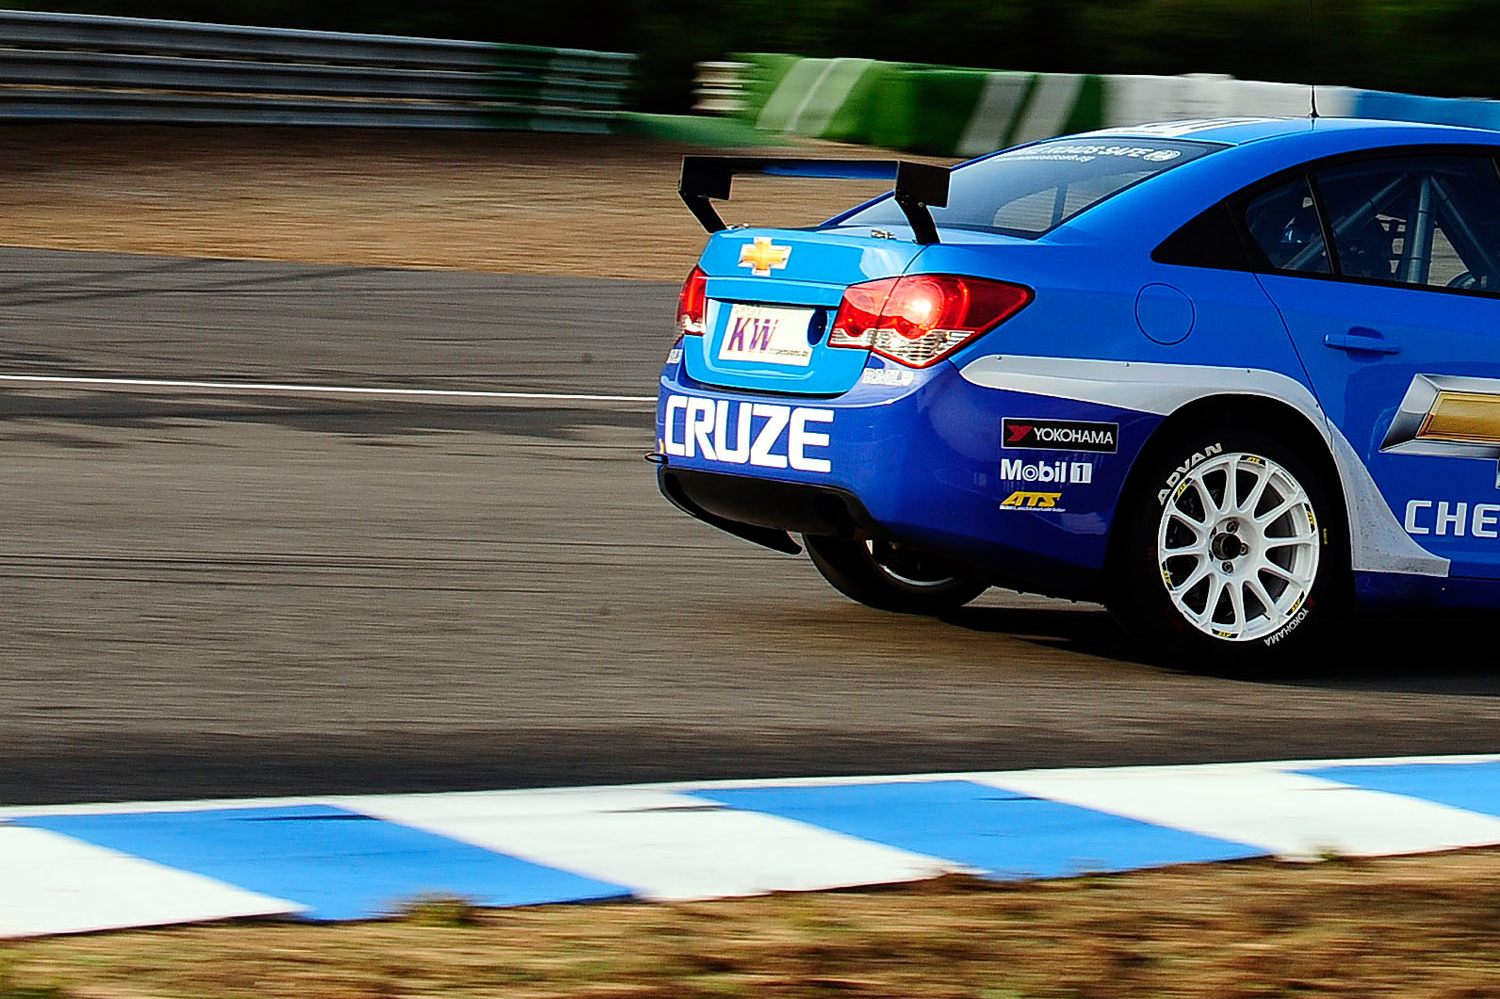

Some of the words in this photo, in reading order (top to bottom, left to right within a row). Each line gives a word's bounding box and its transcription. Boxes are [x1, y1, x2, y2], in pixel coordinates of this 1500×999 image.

[727, 317, 779, 352] KW
[664, 395, 834, 472] CRUZE
[1033, 427, 1114, 445] YOKOHAMA
[1000, 458, 1067, 483] Mobil
[1157, 442, 1223, 506] ADVAN
[1001, 491, 1062, 507] ATS
[1263, 607, 1310, 647] YOKOHAMA
